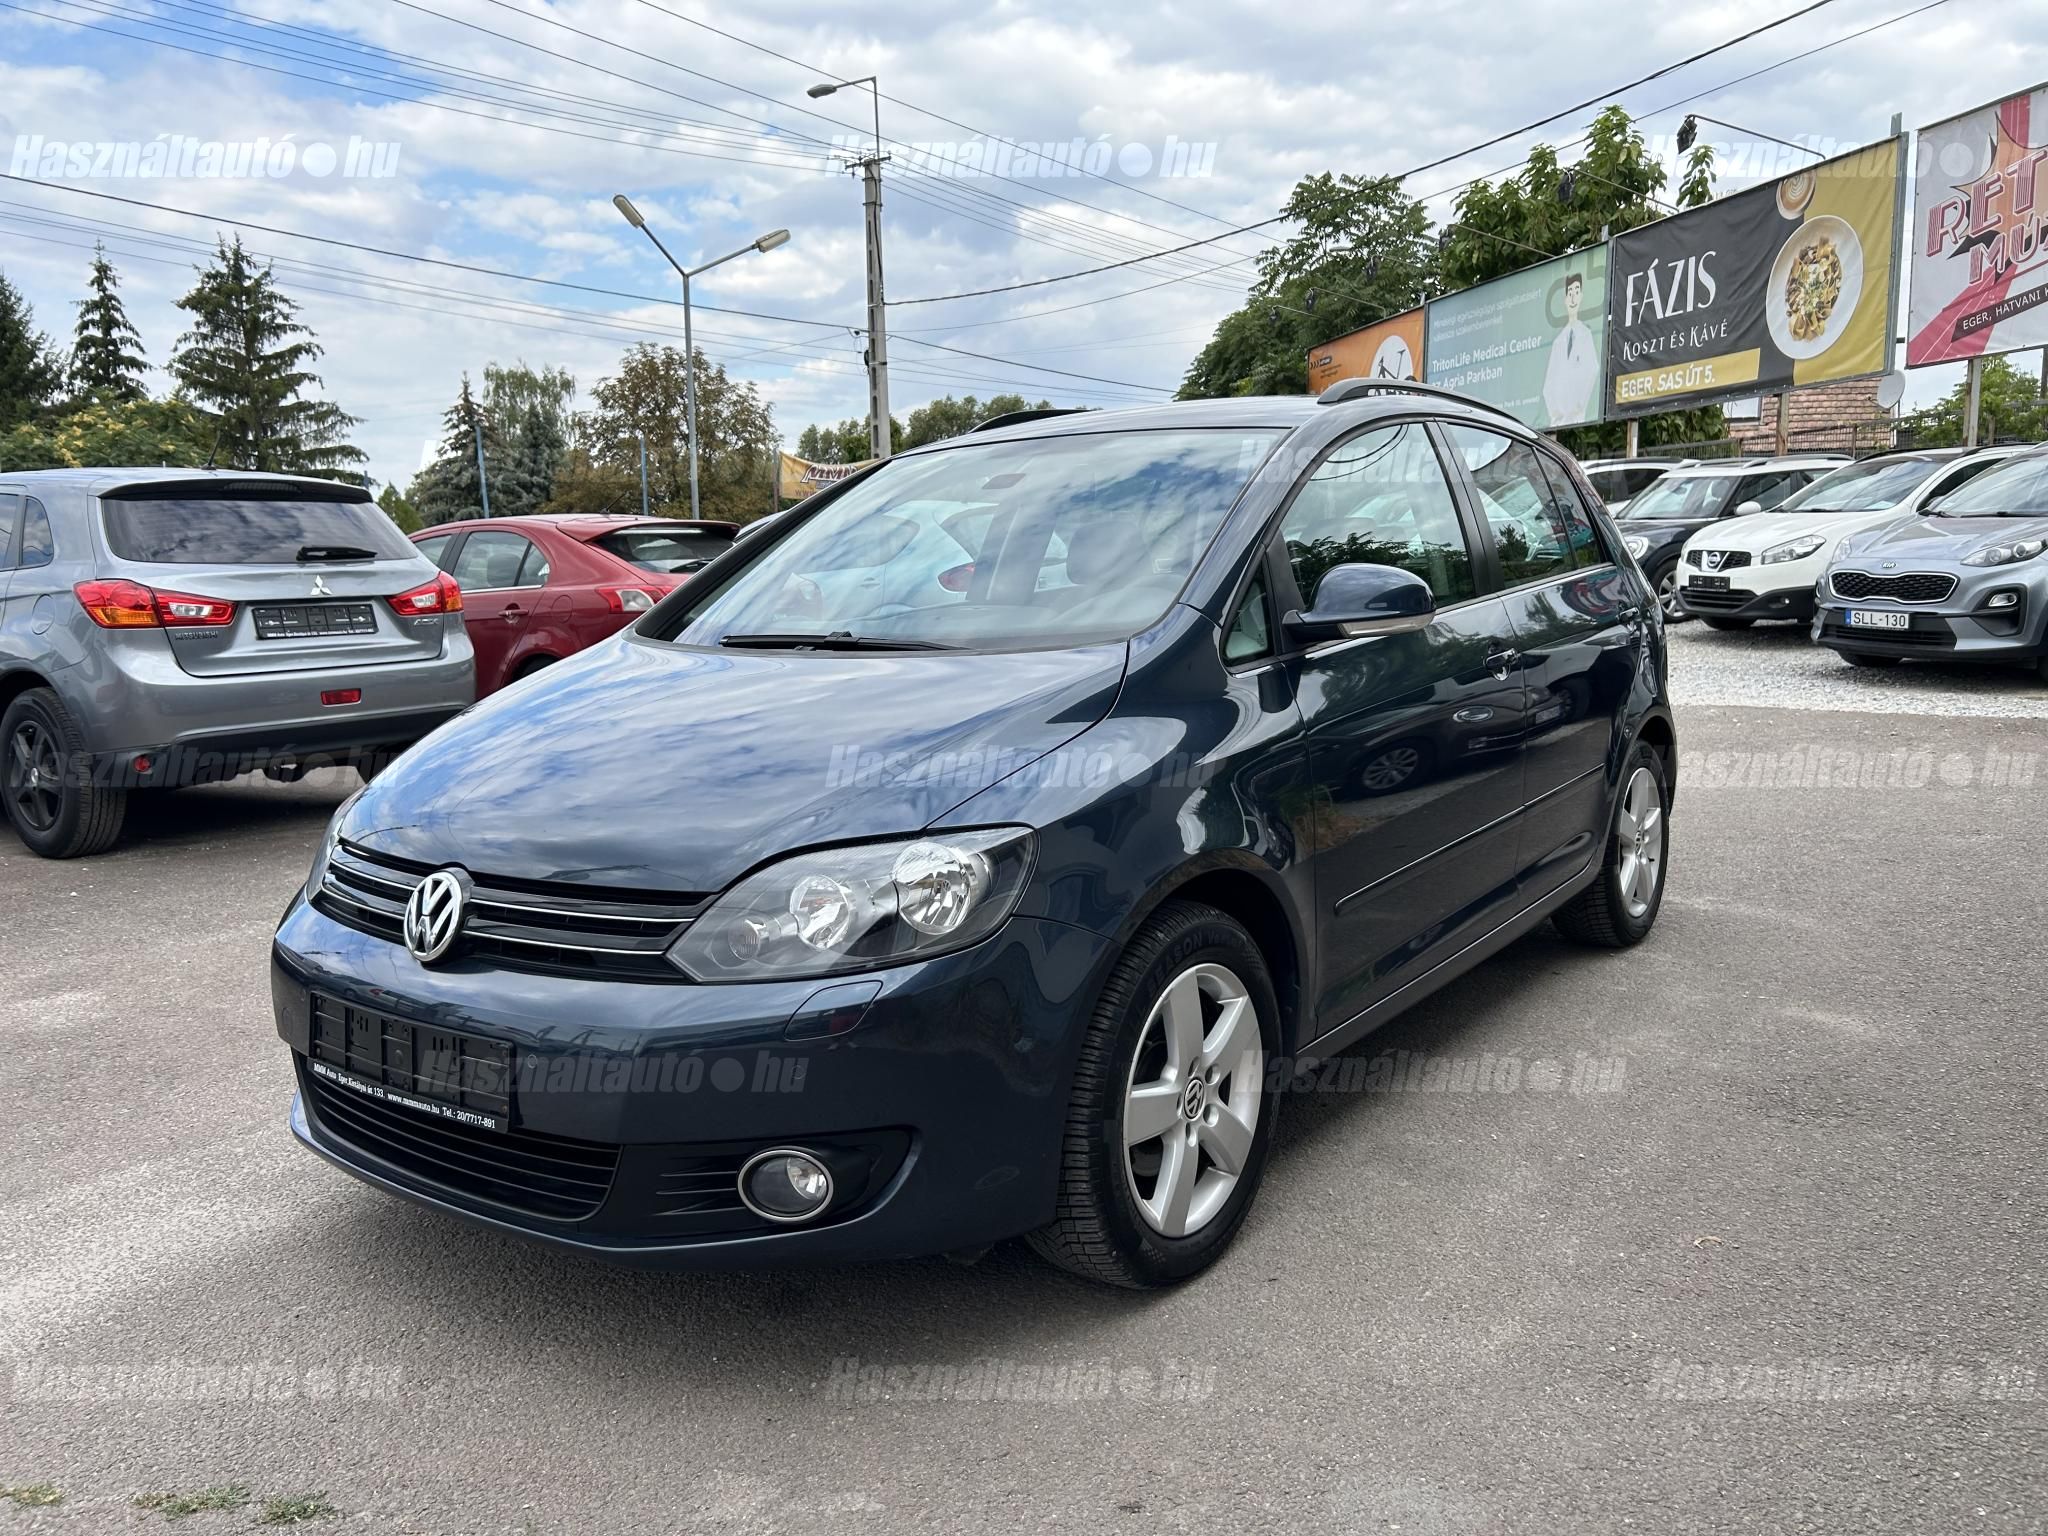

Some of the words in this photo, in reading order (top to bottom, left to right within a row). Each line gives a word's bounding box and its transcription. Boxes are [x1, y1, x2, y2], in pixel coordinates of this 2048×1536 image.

[1969, 212, 2048, 285] MÚ
[1625, 251, 1716, 327] FÁZIS
[1963, 312, 1992, 330] EGER,
[1995, 290, 2041, 317] HATVANI
[1432, 352, 1471, 373] TritonLife
[1473, 342, 1507, 362] Medical
[1510, 336, 1542, 353] Center
[1443, 374, 1464, 390] Agria
[1467, 366, 1503, 384] Parkban
[1657, 373, 1683, 392] SAS
[1685, 364, 1703, 387] ÚT
[1705, 365, 1715, 384] 5.
[1853, 612, 1906, 627] SLL-130
[387, 1093, 440, 1114] www.mmmauto.hu
[442, 1106, 456, 1119] Tel.:
[457, 1111, 496, 1129] 20/7717-891
